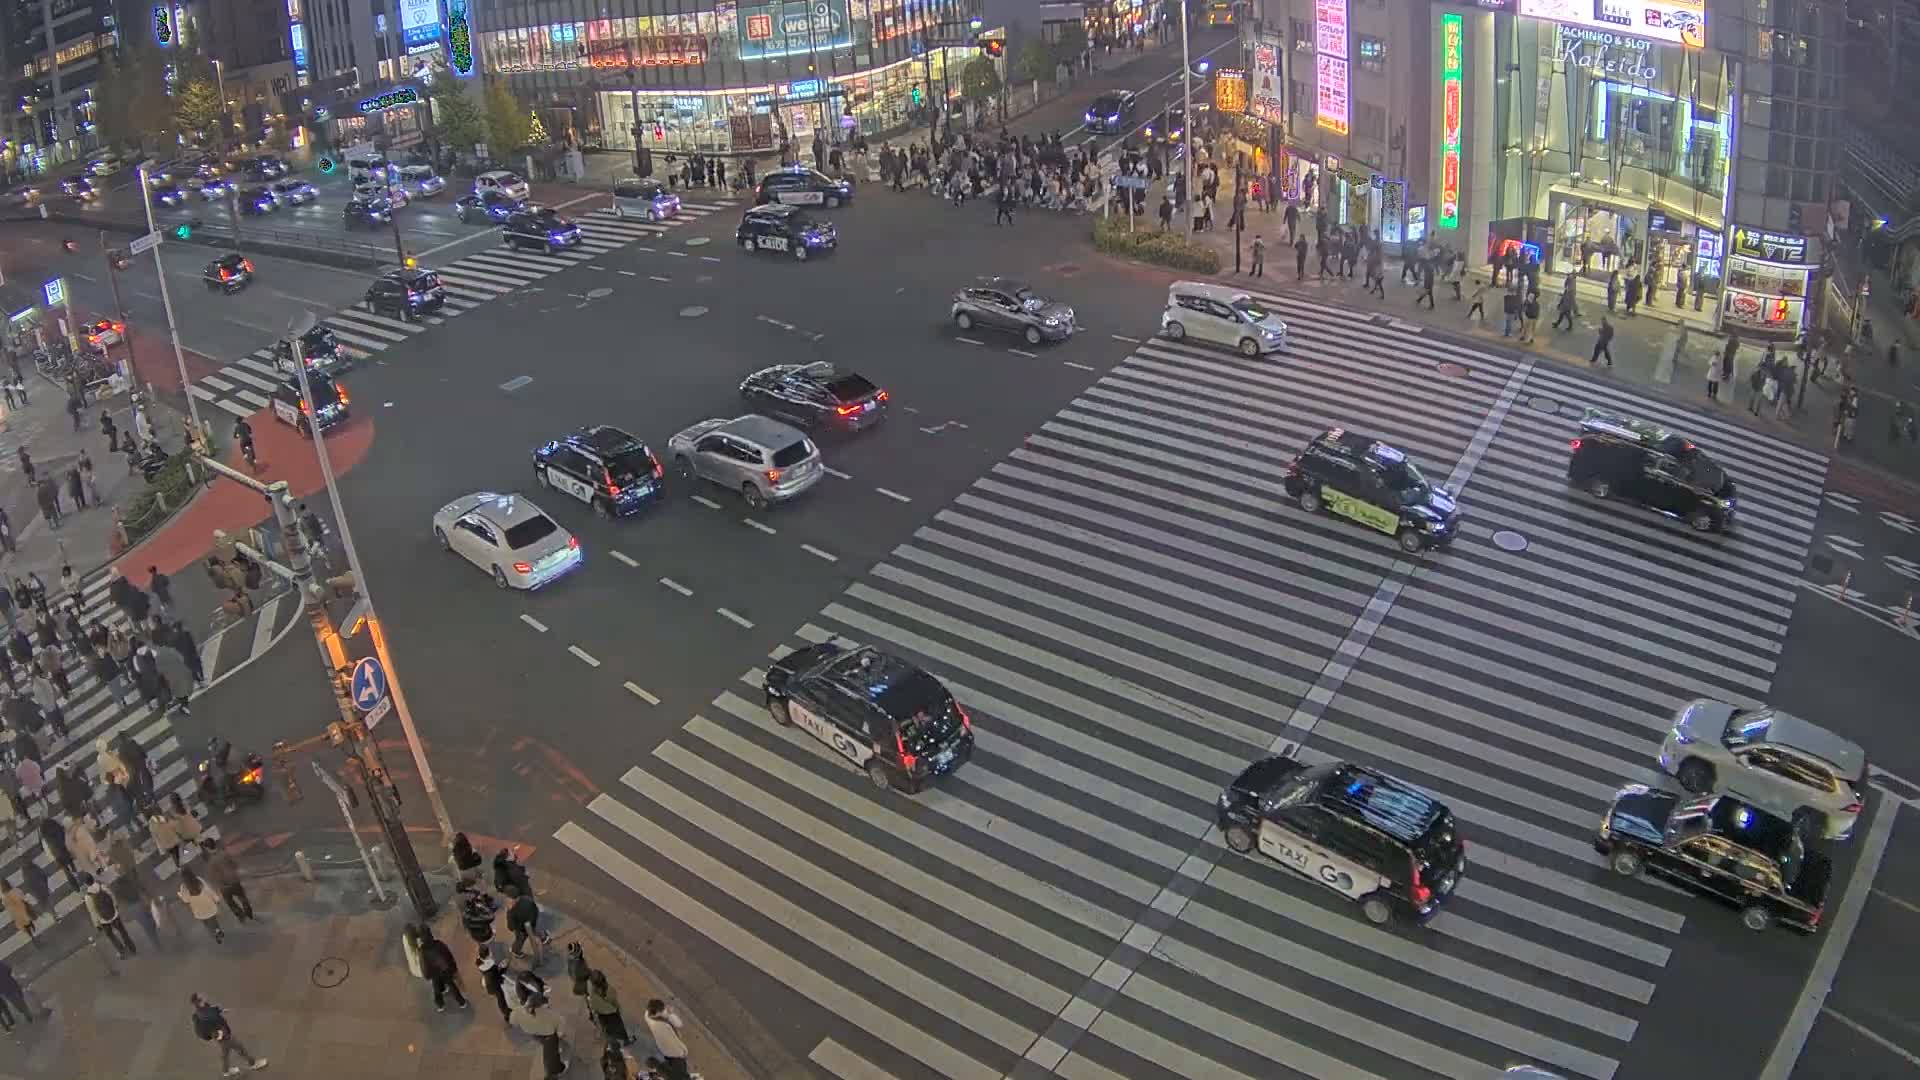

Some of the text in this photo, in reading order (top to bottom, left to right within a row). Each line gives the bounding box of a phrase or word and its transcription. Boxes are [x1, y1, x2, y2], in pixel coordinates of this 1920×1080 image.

[1558, 26, 1612, 44] PACHINKO
[1625, 37, 1652, 52] SLOT
[1562, 38, 1657, 80] Kaleido
[802, 713, 858, 758] TAXI GO
[1279, 844, 1354, 891] TAXI GO
